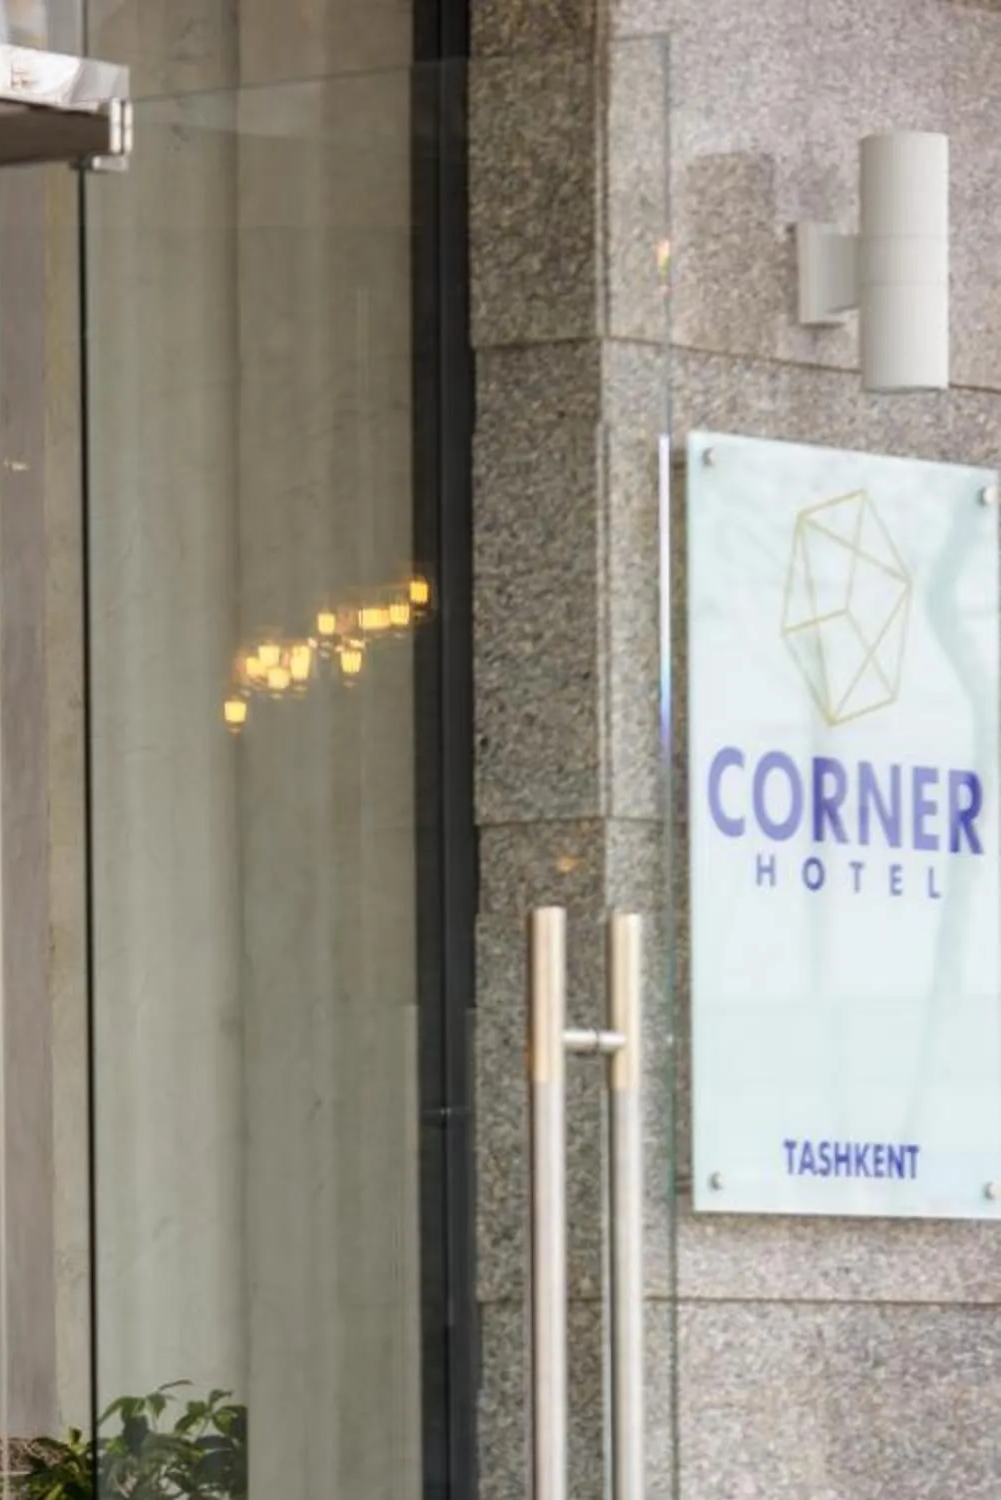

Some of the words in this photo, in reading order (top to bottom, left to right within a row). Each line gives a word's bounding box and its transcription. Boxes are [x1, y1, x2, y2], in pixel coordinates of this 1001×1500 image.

[707, 745, 984, 855] CORNER
[756, 853, 941, 899] HOTEL
[783, 1138, 919, 1179] TASHKENT
